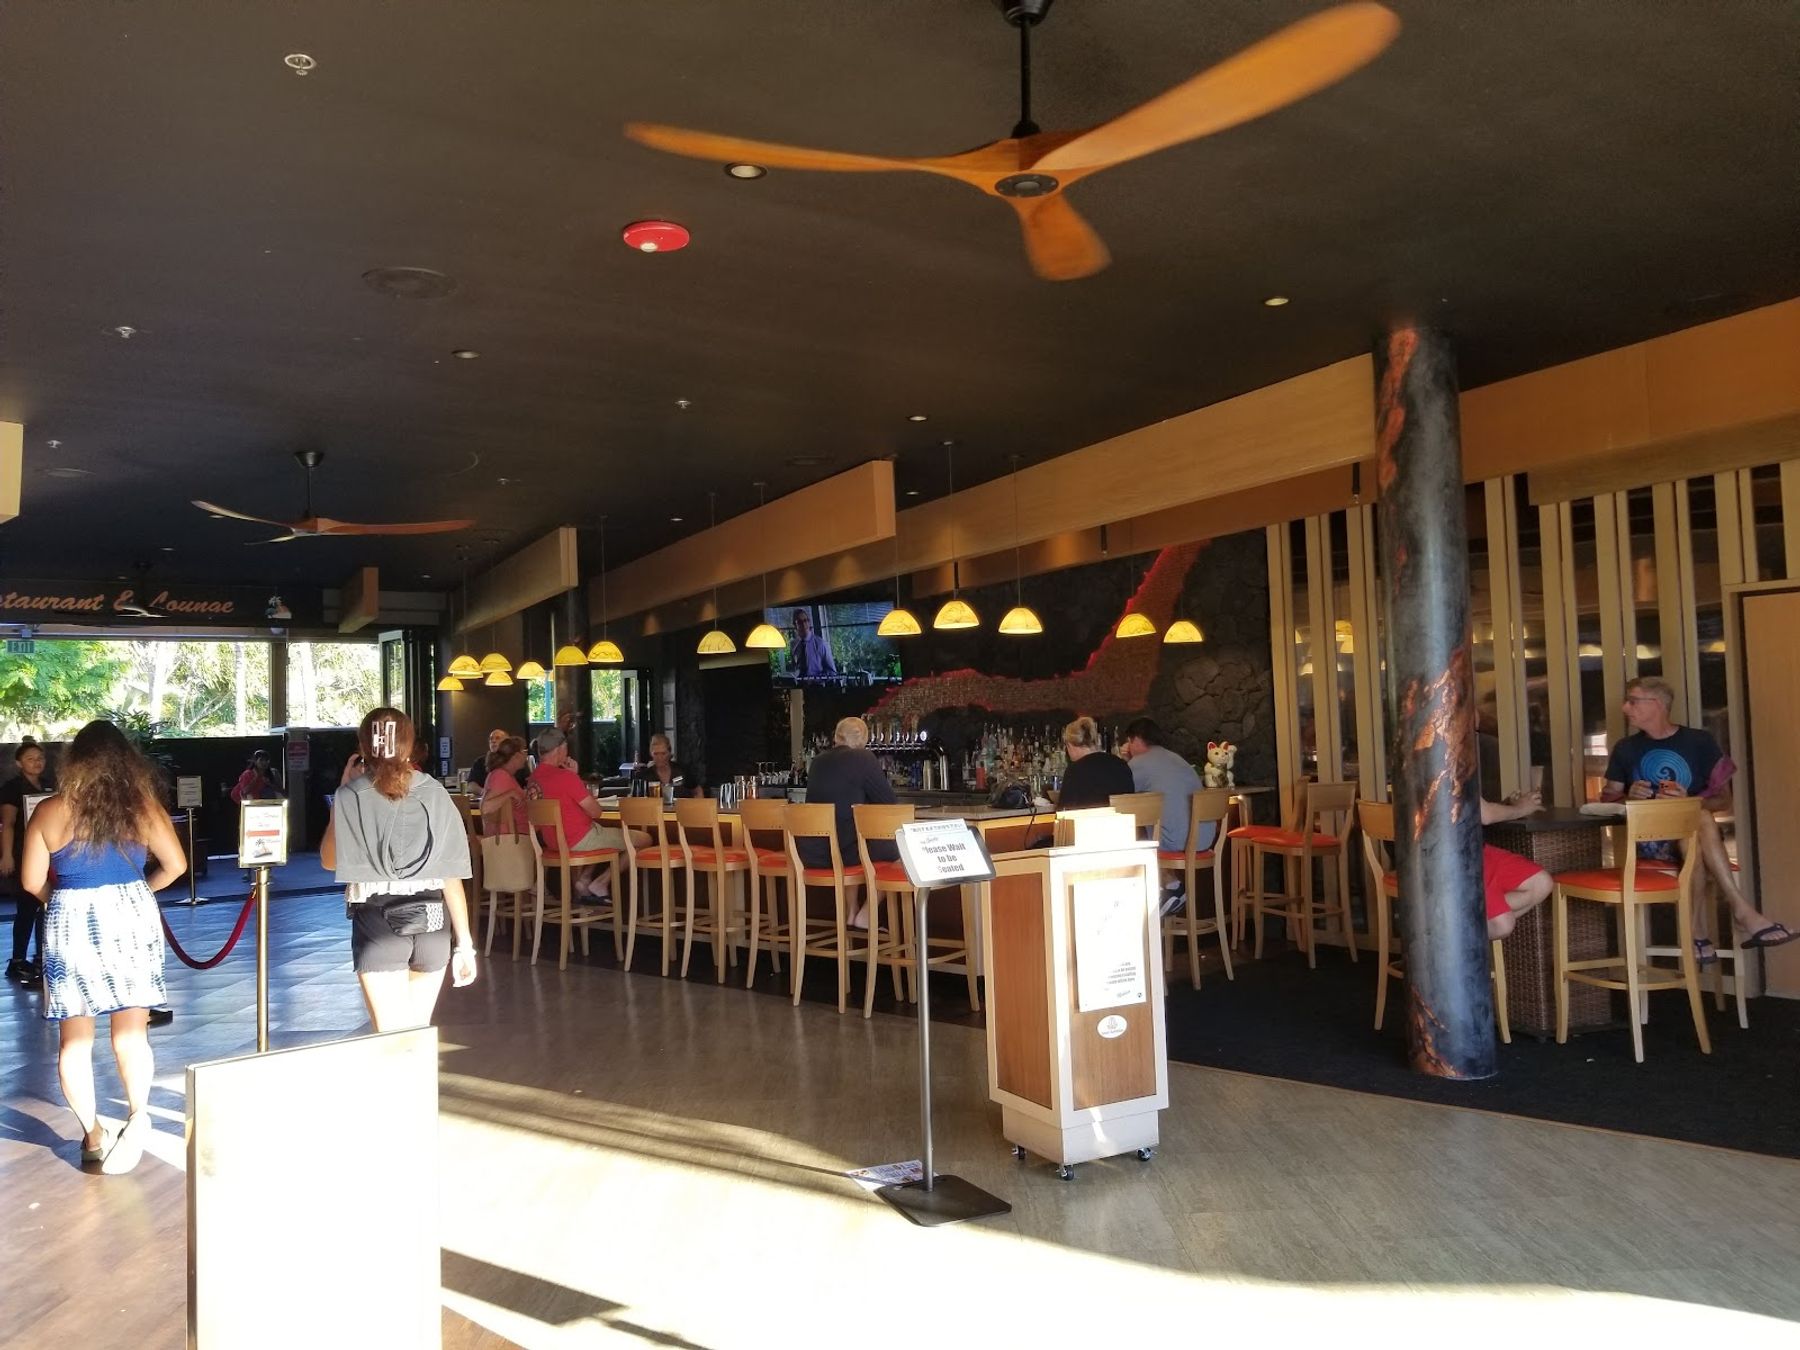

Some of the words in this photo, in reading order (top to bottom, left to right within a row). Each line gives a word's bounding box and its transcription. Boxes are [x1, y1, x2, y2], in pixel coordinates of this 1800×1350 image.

[947, 842, 967, 852] Wait
[937, 855, 946, 863] to
[946, 854, 958, 862] be
